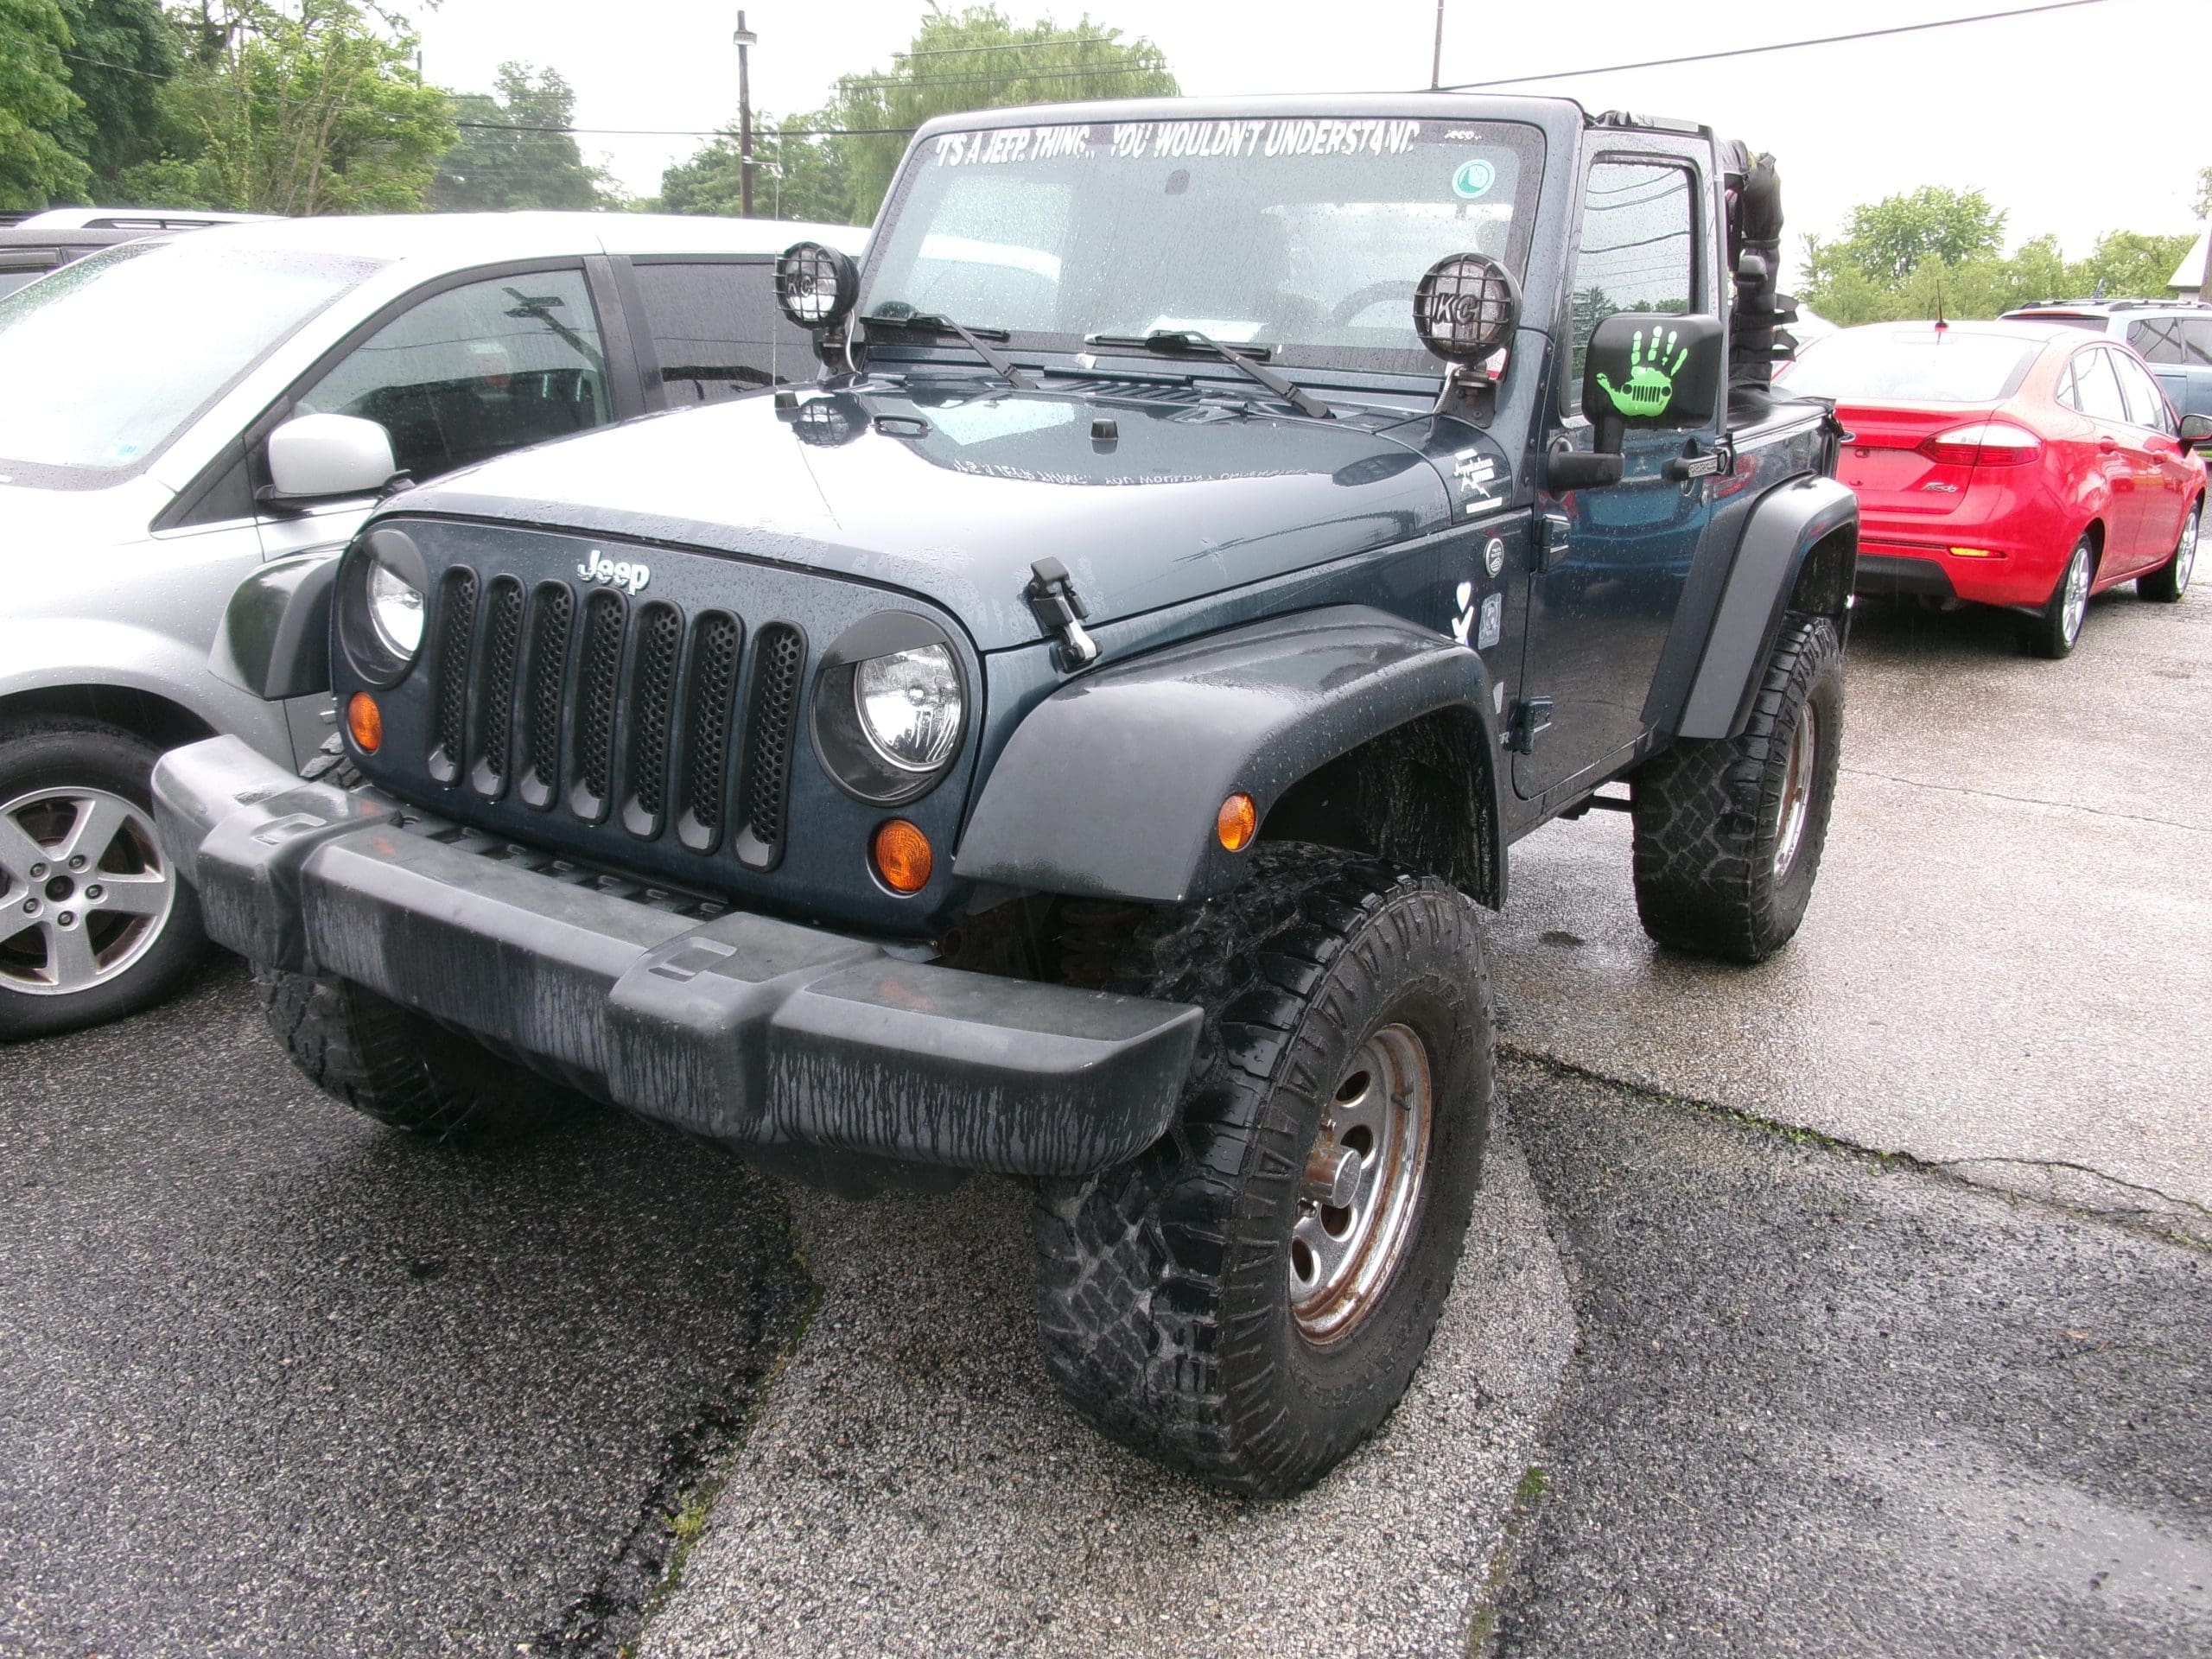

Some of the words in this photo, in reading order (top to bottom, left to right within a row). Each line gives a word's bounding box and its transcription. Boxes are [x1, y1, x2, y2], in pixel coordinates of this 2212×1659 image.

[965, 131, 983, 166] A
[1109, 123, 1154, 158] YOU
[1154, 120, 1267, 158] WOULDN'T
[576, 550, 651, 596] Jeep
